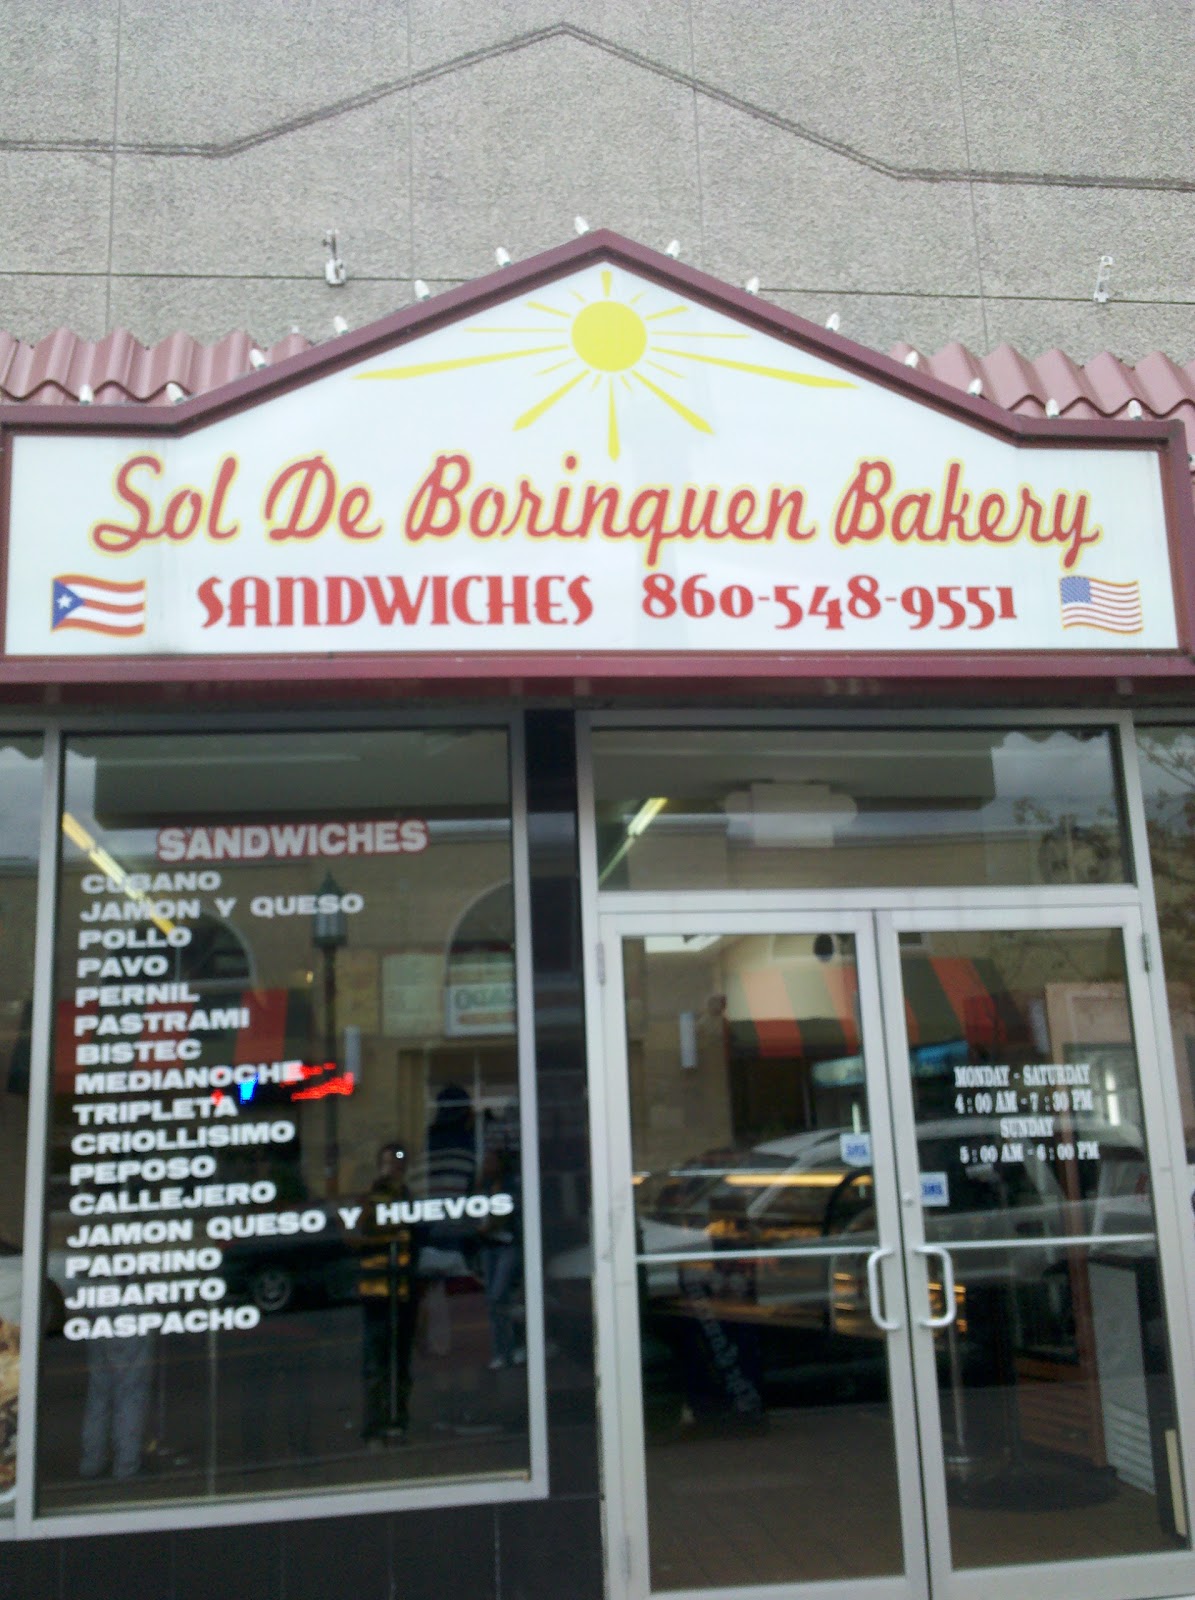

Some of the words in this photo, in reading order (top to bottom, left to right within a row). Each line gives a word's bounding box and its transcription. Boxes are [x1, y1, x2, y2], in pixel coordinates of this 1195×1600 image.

[91, 451, 238, 557] Sol
[265, 452, 384, 543] De
[404, 453, 815, 569] Borinquen
[833, 456, 1101, 570] Bakery
[197, 575, 594, 628] SANDWICHES
[641, 572, 1017, 630] 860-548-9551
[157, 818, 430, 862] SANDWICHES
[81, 870, 222, 894] CUBANO
[80, 897, 200, 922] JAMON
[214, 897, 236, 917] Y
[250, 893, 364, 918] QUESO
[78, 926, 192, 950] POLLO
[77, 954, 168, 978] PAVO
[75, 982, 200, 1007] PERNIL
[74, 1007, 250, 1037] PASTRAMI
[75, 1038, 202, 1066] BISTEC
[74, 1061, 306, 1095] MEDIANOCHE
[954, 1065, 1012, 1088] MONDAY
[1022, 1064, 1090, 1086] SATURDAY
[72, 1095, 239, 1126] TRIPLETA
[995, 1093, 1018, 1113] AM
[1072, 1089, 1093, 1111] PM
[70, 1120, 296, 1156] CRIOLLISIMO
[1000, 1117, 1054, 1138] SUNDAY
[1001, 1143, 1024, 1162] AM
[1077, 1141, 1100, 1160] PM
[69, 1155, 217, 1186] PEPOSO
[69, 1181, 277, 1216] CALLEJERO
[67, 1218, 193, 1249] JAMON
[206, 1209, 326, 1241] QUESO
[337, 1206, 364, 1231] Y
[376, 1193, 514, 1225] HUEVOS
[65, 1247, 223, 1280] PADRINO
[64, 1278, 227, 1310] JIBARITO
[63, 1305, 261, 1342] GASPACHO
